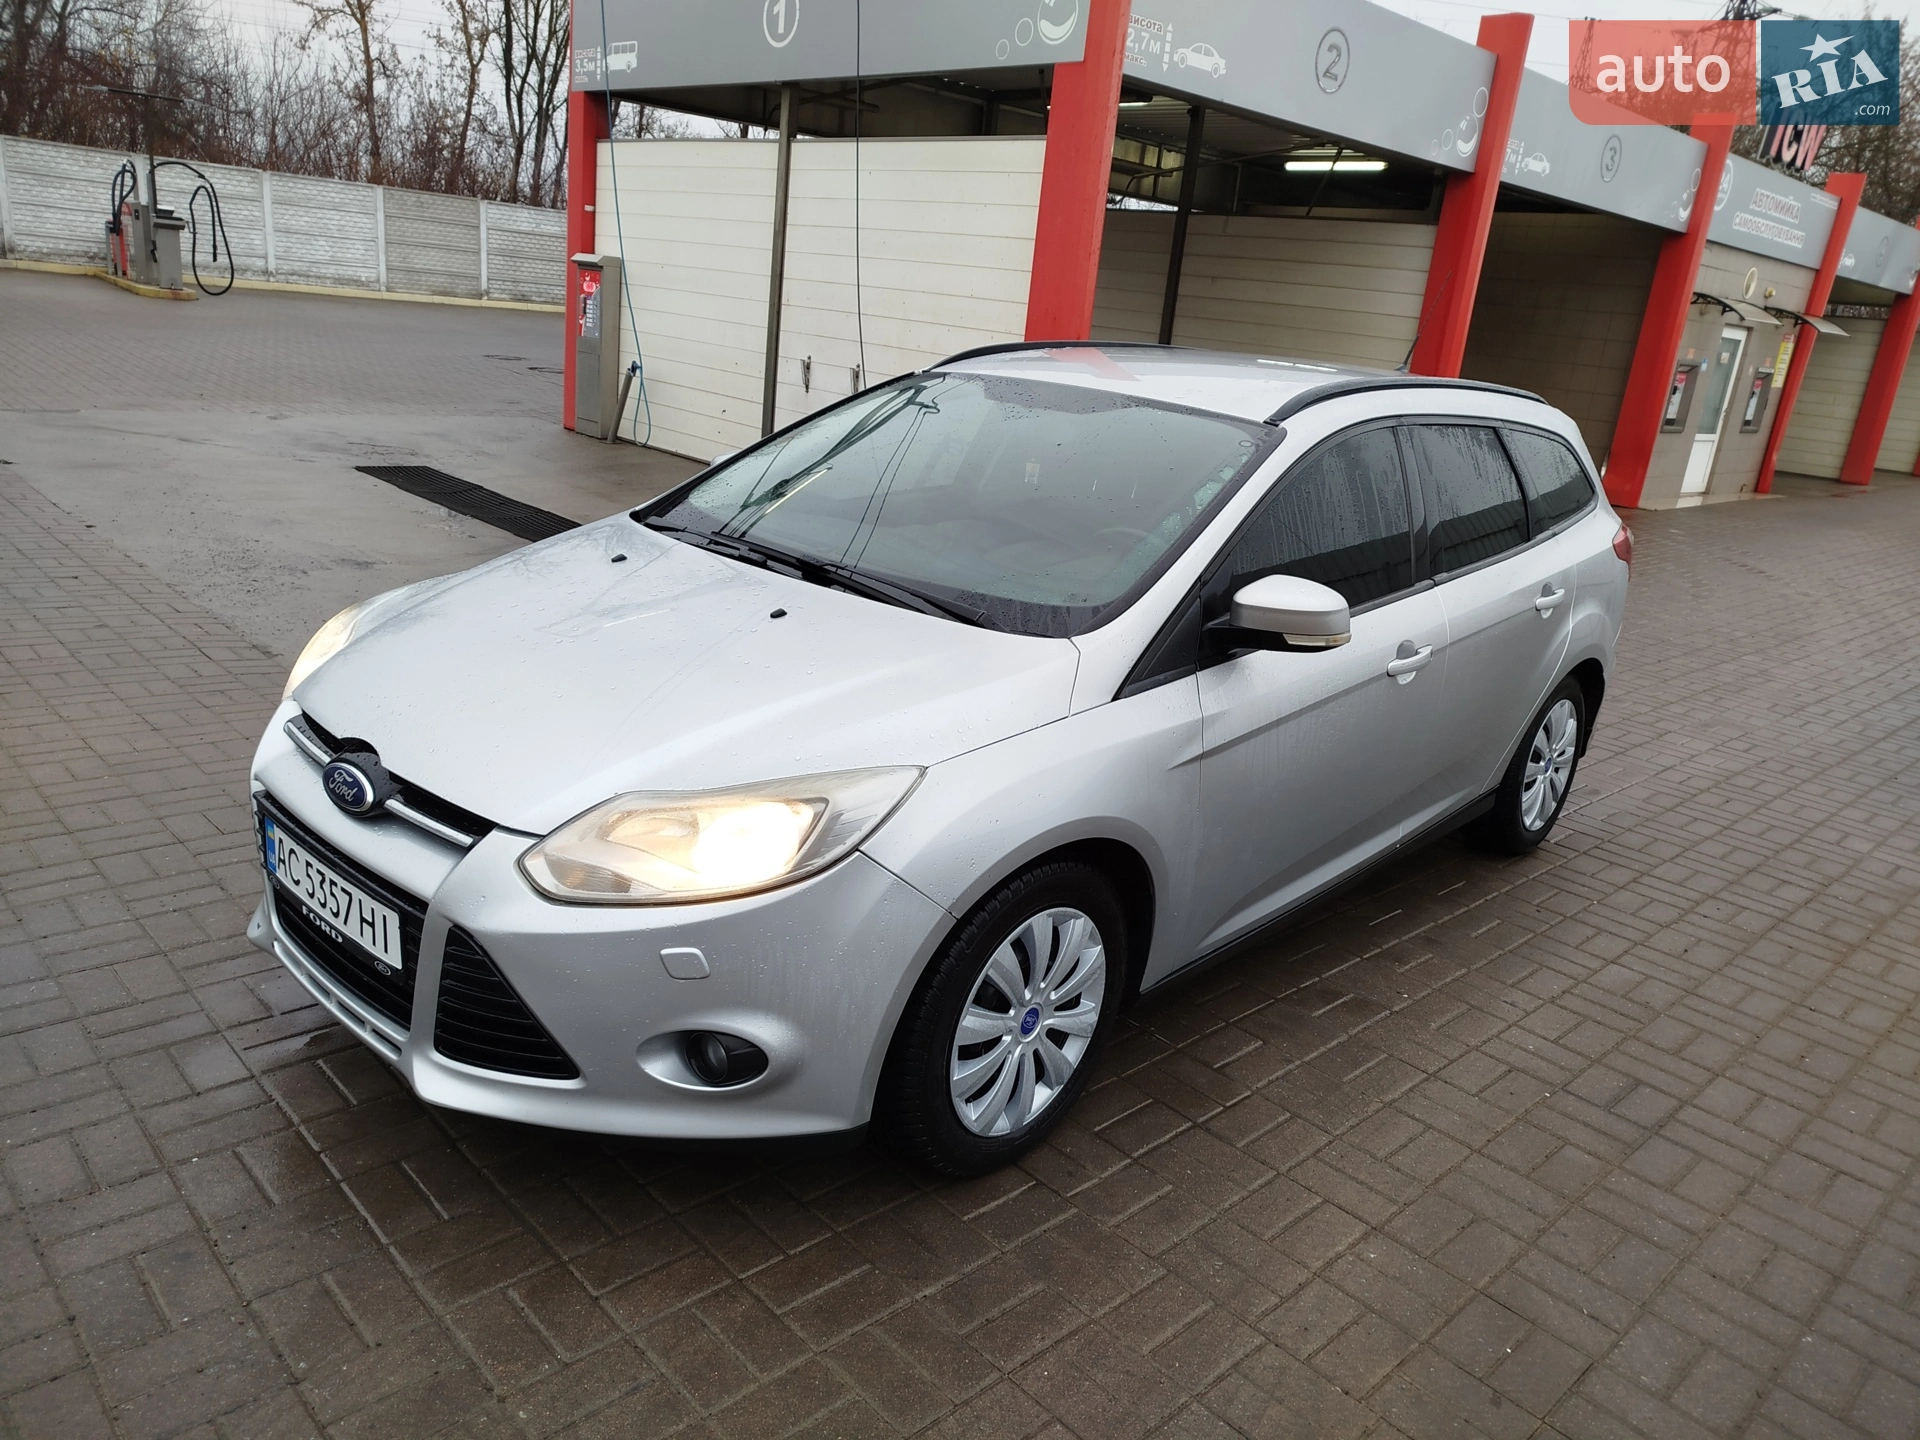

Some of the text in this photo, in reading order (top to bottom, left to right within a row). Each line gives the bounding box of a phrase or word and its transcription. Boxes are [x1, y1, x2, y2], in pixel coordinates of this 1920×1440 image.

[773, 0, 786, 34] 1
[1127, 28, 1161, 54] 2,7м
[575, 59, 596, 75] 3,5м
[1323, 43, 1342, 81] 2
[1749, 187, 1801, 224] АВТОМИЙКА
[328, 769, 358, 802] Ford
[277, 836, 389, 954] AC 5357 HI
[301, 904, 343, 944] FORD
